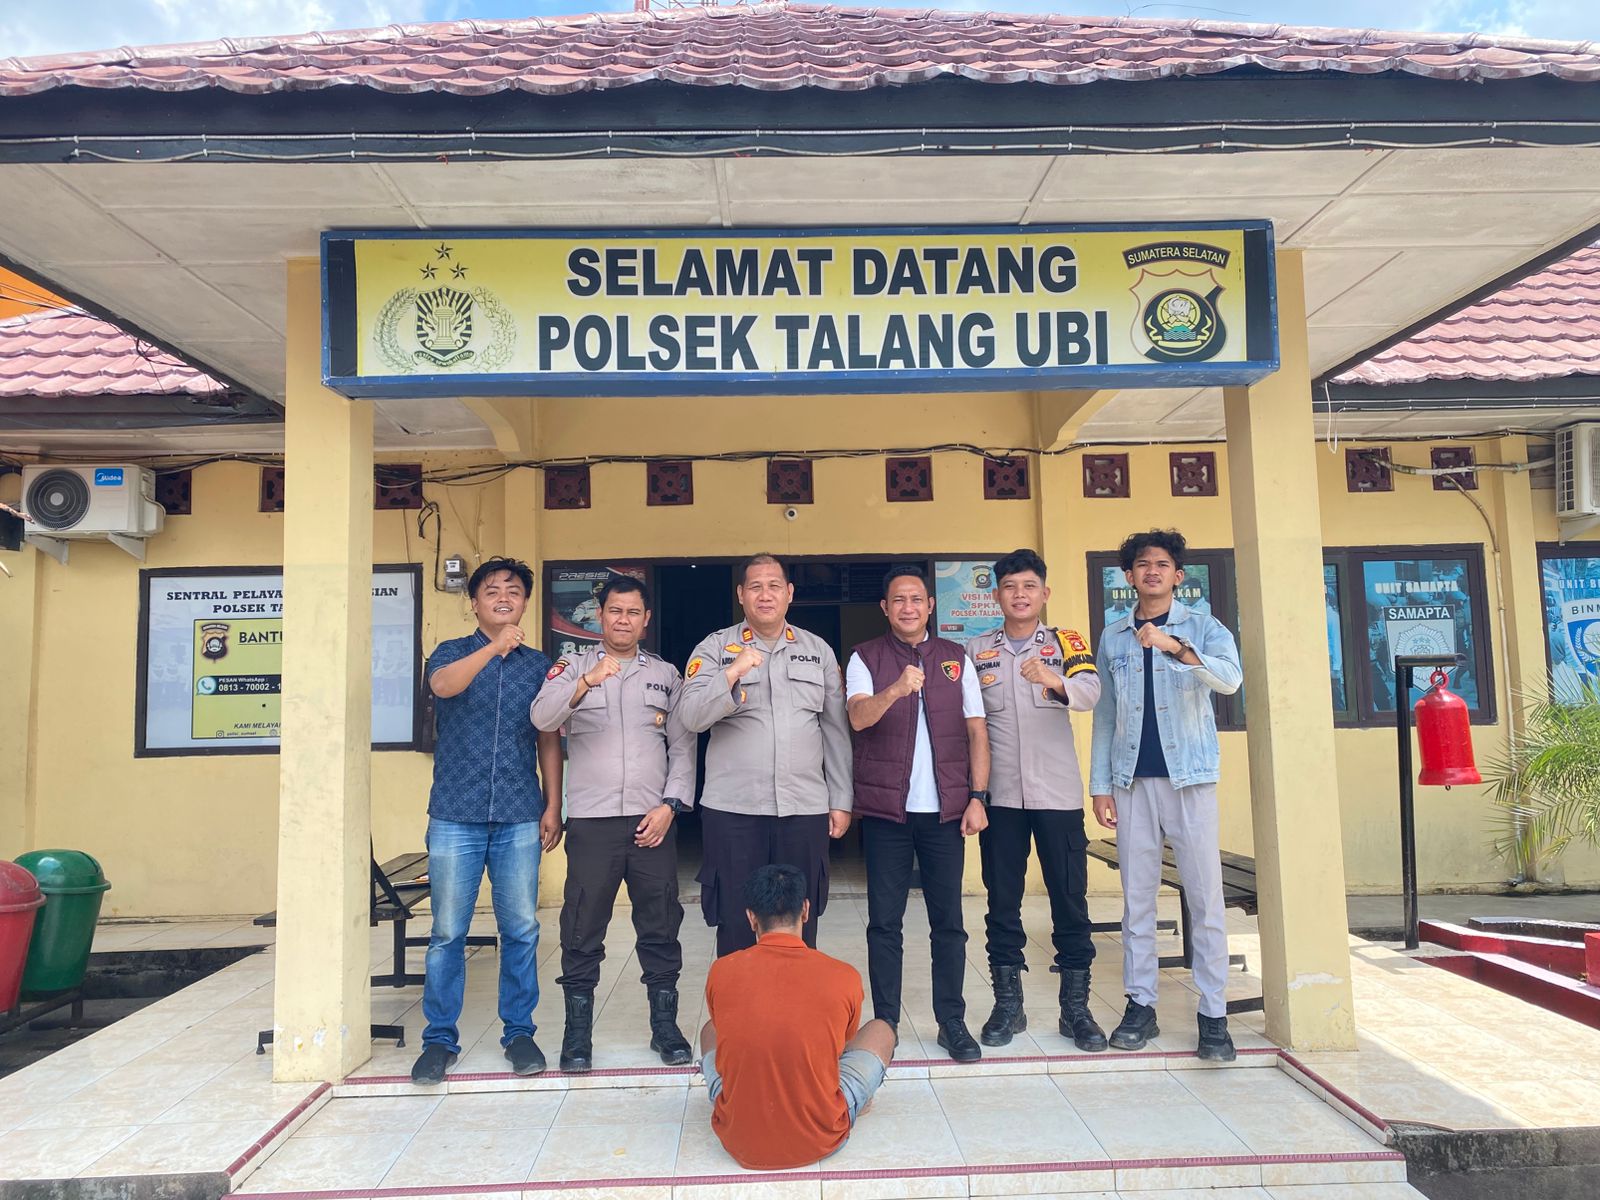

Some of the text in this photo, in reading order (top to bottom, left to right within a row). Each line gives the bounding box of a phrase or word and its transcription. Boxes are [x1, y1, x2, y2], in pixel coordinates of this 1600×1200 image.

[1127, 246, 1226, 265] SUMATERA SELATAN
[567, 245, 1077, 297] SELAMAT DATANG
[538, 310, 1109, 371] POLSEK TALANG UBI
[1375, 580, 1459, 594] UNIT SAMAPTA
[1558, 579, 1585, 589] UNIT
[167, 591, 228, 601] SENTRAL
[962, 593, 980, 601] VISI
[1112, 589, 1138, 600] UNIT
[213, 604, 265, 614] POLSEK
[1388, 607, 1451, 620] SAMAPTA
[790, 654, 821, 664] POLRI
[1040, 658, 1062, 667] OLRI
[218, 684, 238, 692] 0813
[246, 683, 269, 691] 70002
